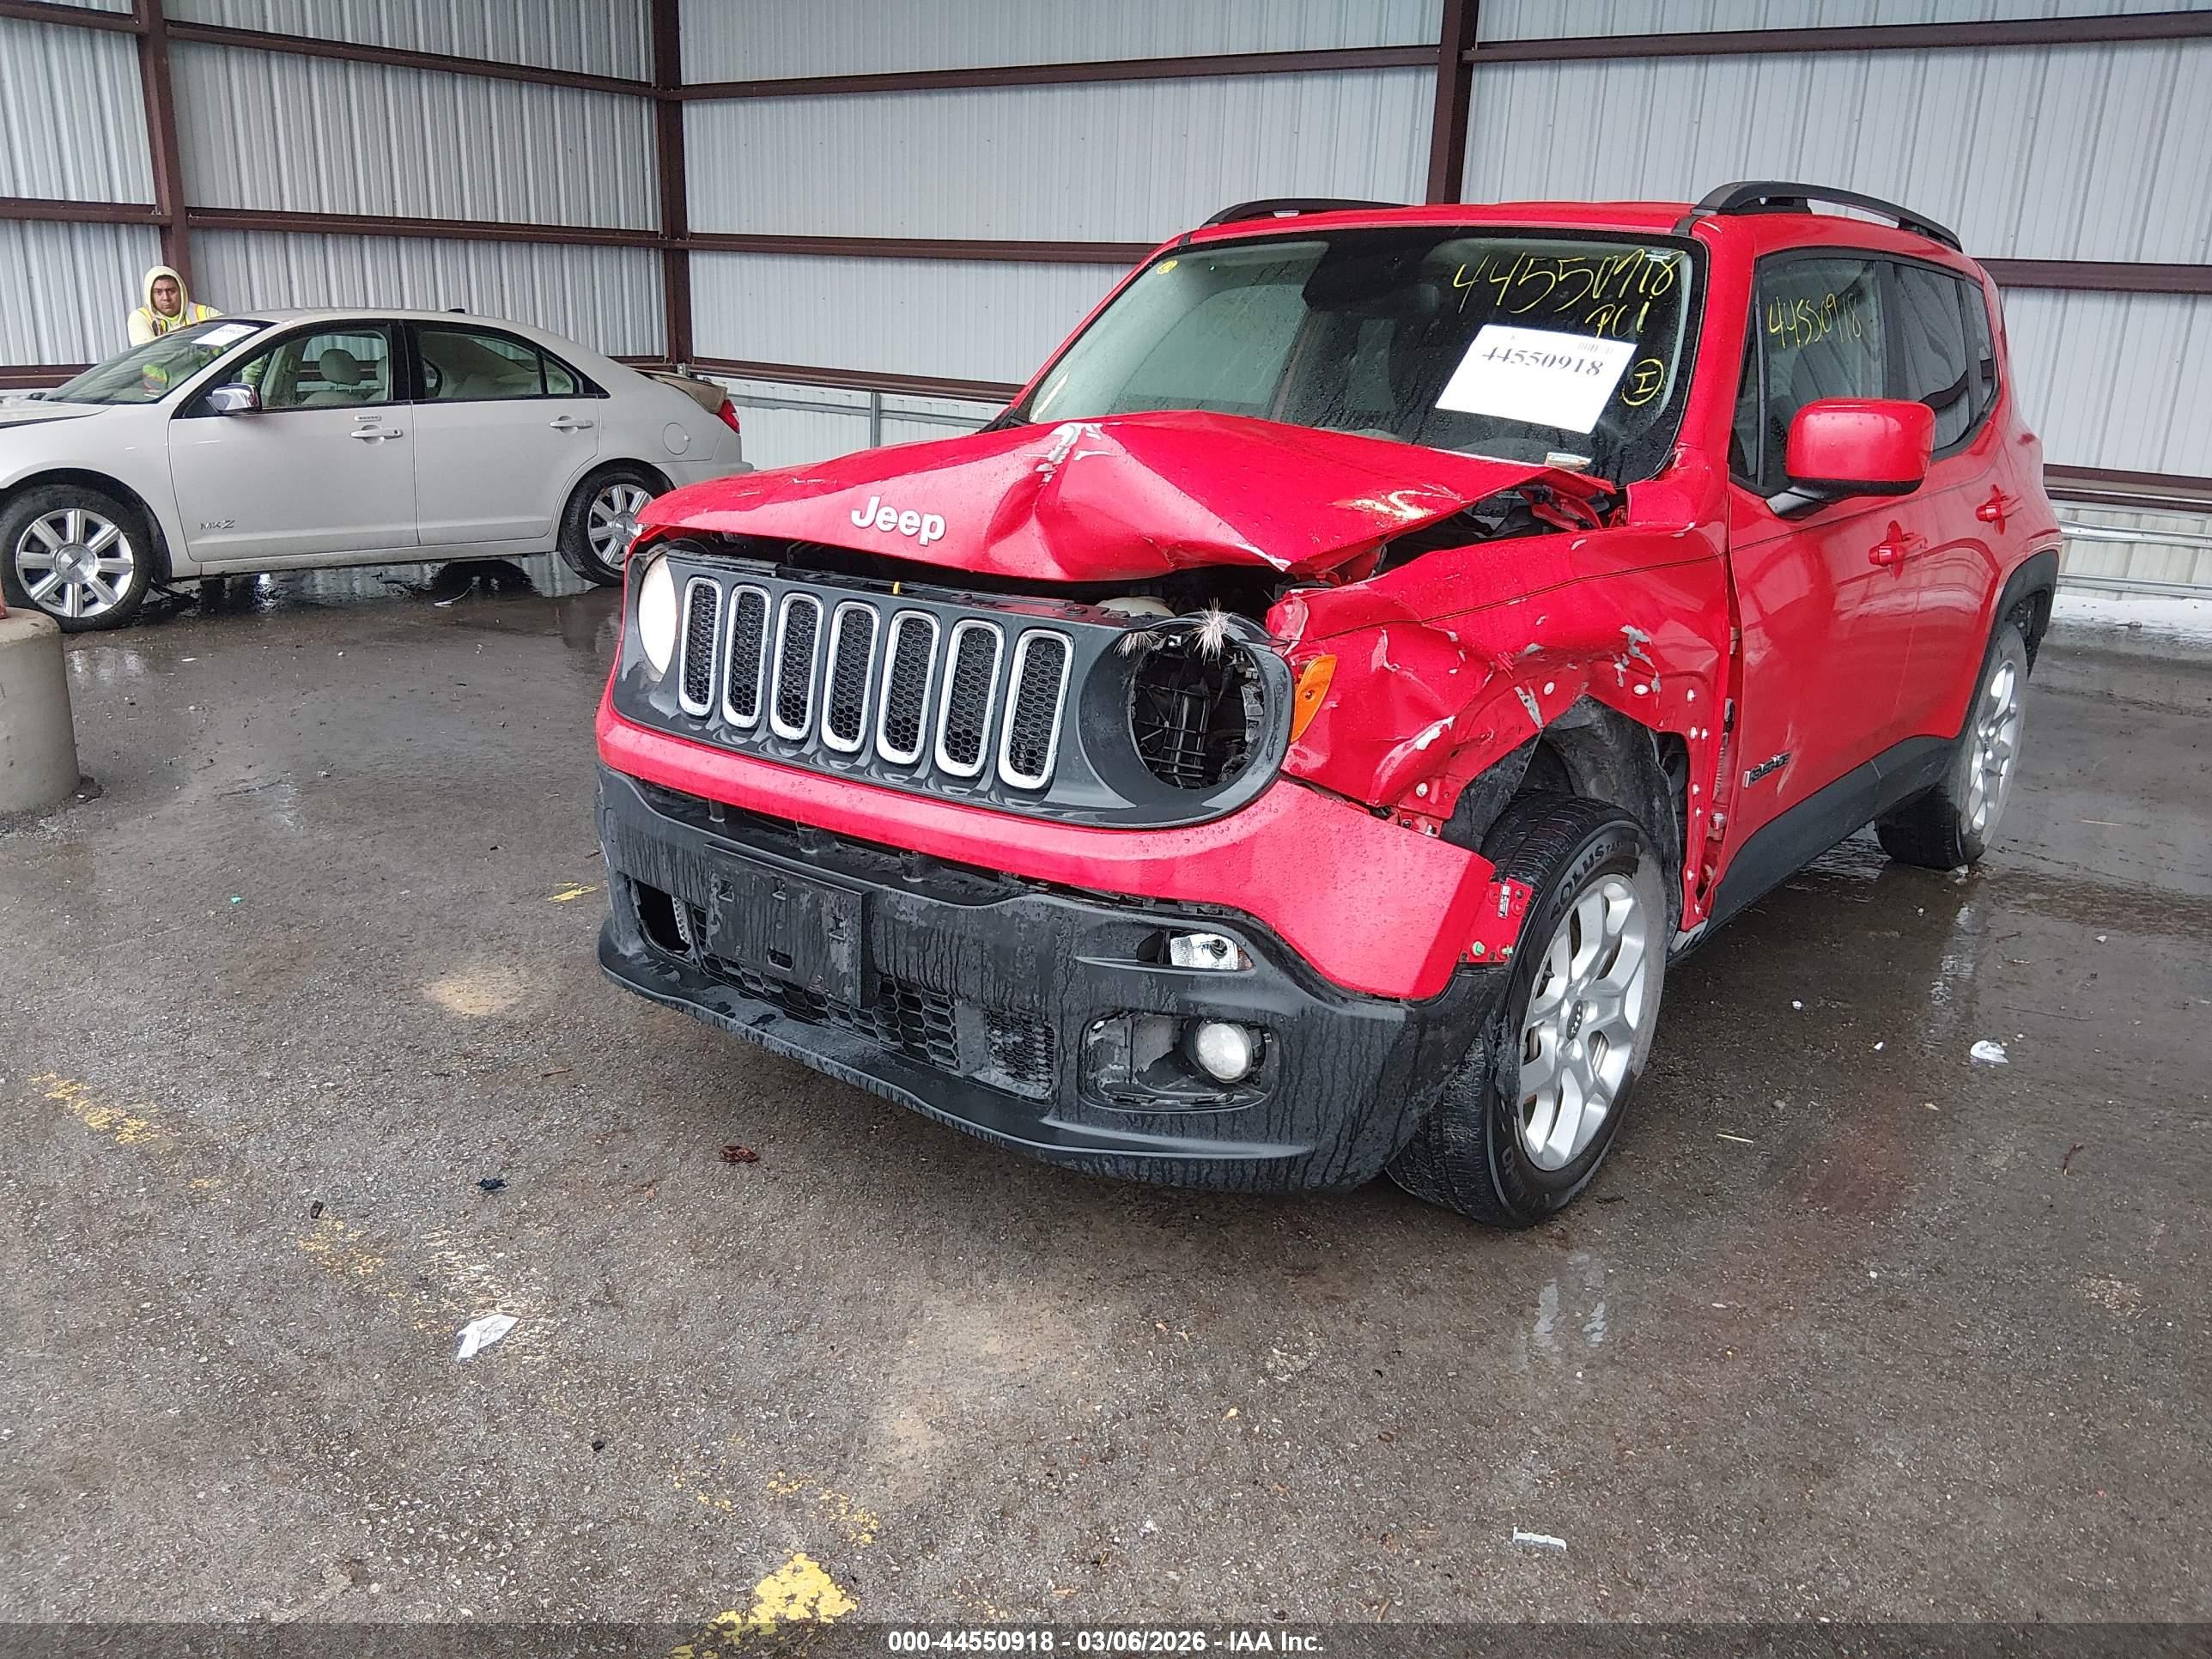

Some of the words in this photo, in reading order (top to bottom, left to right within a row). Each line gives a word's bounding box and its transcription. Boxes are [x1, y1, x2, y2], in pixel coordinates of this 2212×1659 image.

[1769, 293, 1862, 349] 44550918
[1482, 345, 1604, 376] 44550918
[199, 519, 235, 530] MKZ
[851, 495, 947, 548] Jeep
